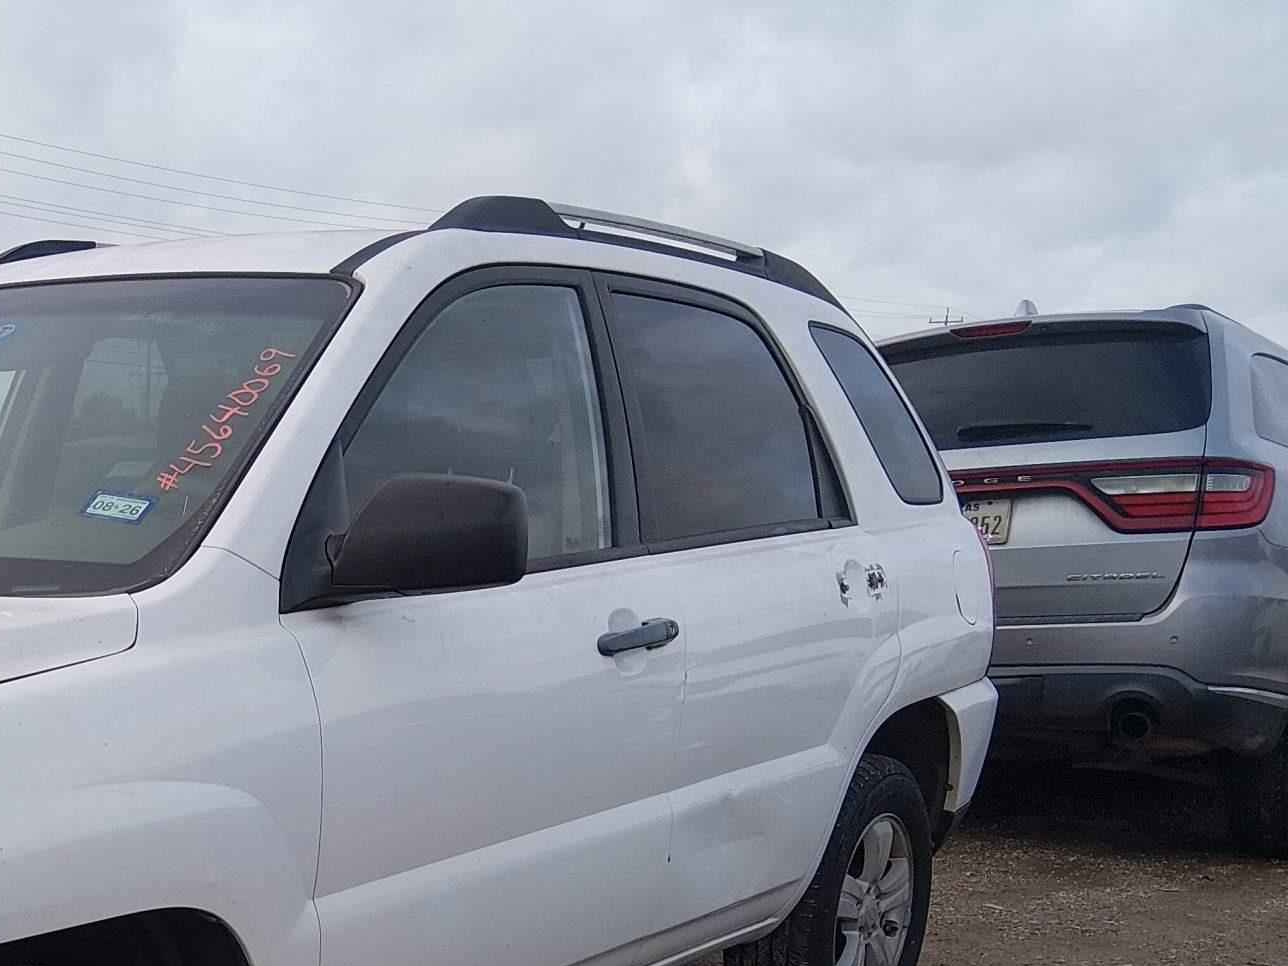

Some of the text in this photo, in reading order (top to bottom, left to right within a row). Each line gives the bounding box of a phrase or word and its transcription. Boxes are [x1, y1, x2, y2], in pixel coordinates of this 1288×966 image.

[157, 347, 297, 491] #45640069
[92, 500, 143, 516] 08 26
[1066, 572, 1166, 582] CITADEL
